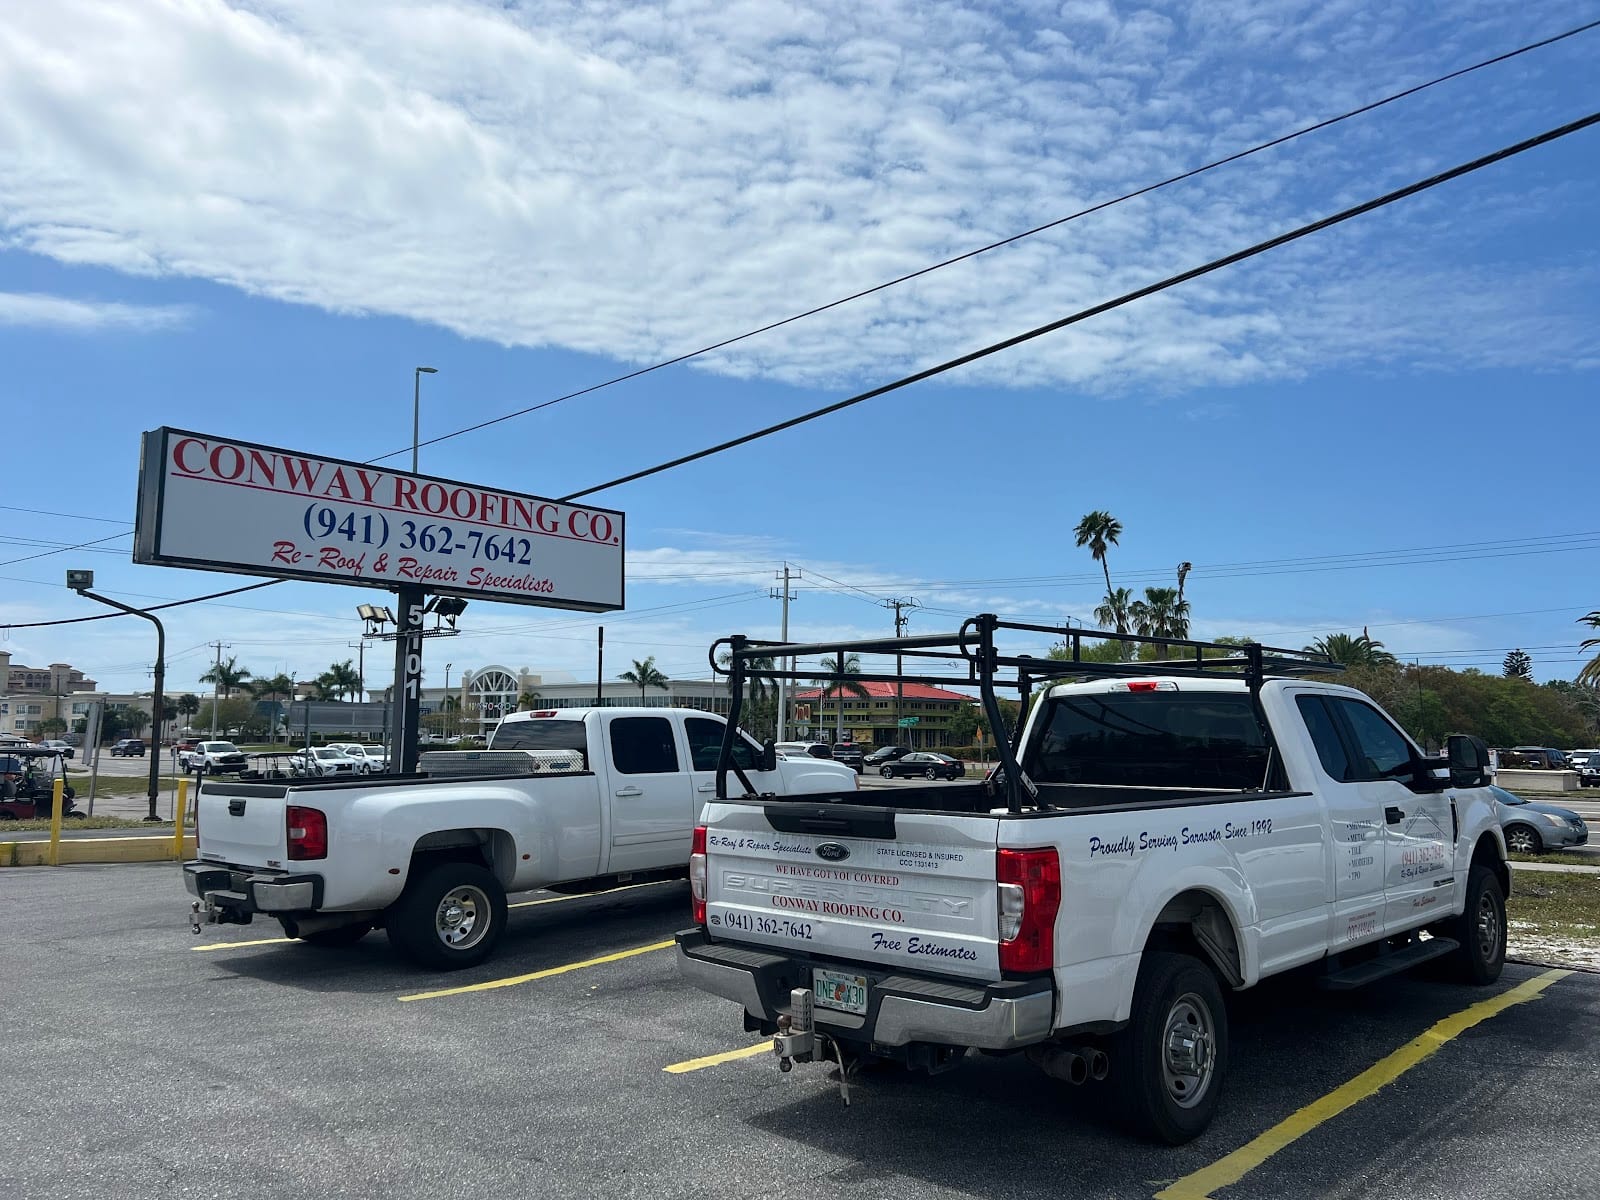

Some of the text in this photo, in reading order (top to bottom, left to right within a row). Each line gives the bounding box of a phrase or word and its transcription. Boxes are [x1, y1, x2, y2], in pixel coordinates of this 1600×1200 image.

[172, 438, 620, 544] CONWAY ROOFING CO.
[304, 502, 532, 565] (941) 362-7642
[271, 540, 555, 593] Re-Roof & Repair Specialists
[739, 839, 745, 848] &
[746, 839, 770, 851] Repair
[772, 841, 812, 854] Specialists
[821, 845, 840, 858] Ford
[1089, 818, 1272, 857] Proudly Serving Sarasota Since 1992
[877, 848, 895, 856] STATE
[896, 850, 927, 859] LICENSED
[934, 853, 964, 861] INSURED
[899, 859, 912, 867] CCC
[727, 875, 844, 900] SUPER
[776, 865, 899, 886] WE HAVE GOT YOU COVERED
[772, 895, 905, 923] CONWAY ROOFING CO.
[724, 910, 812, 939] (941) 362-7642
[871, 932, 978, 960] Free Estimates
